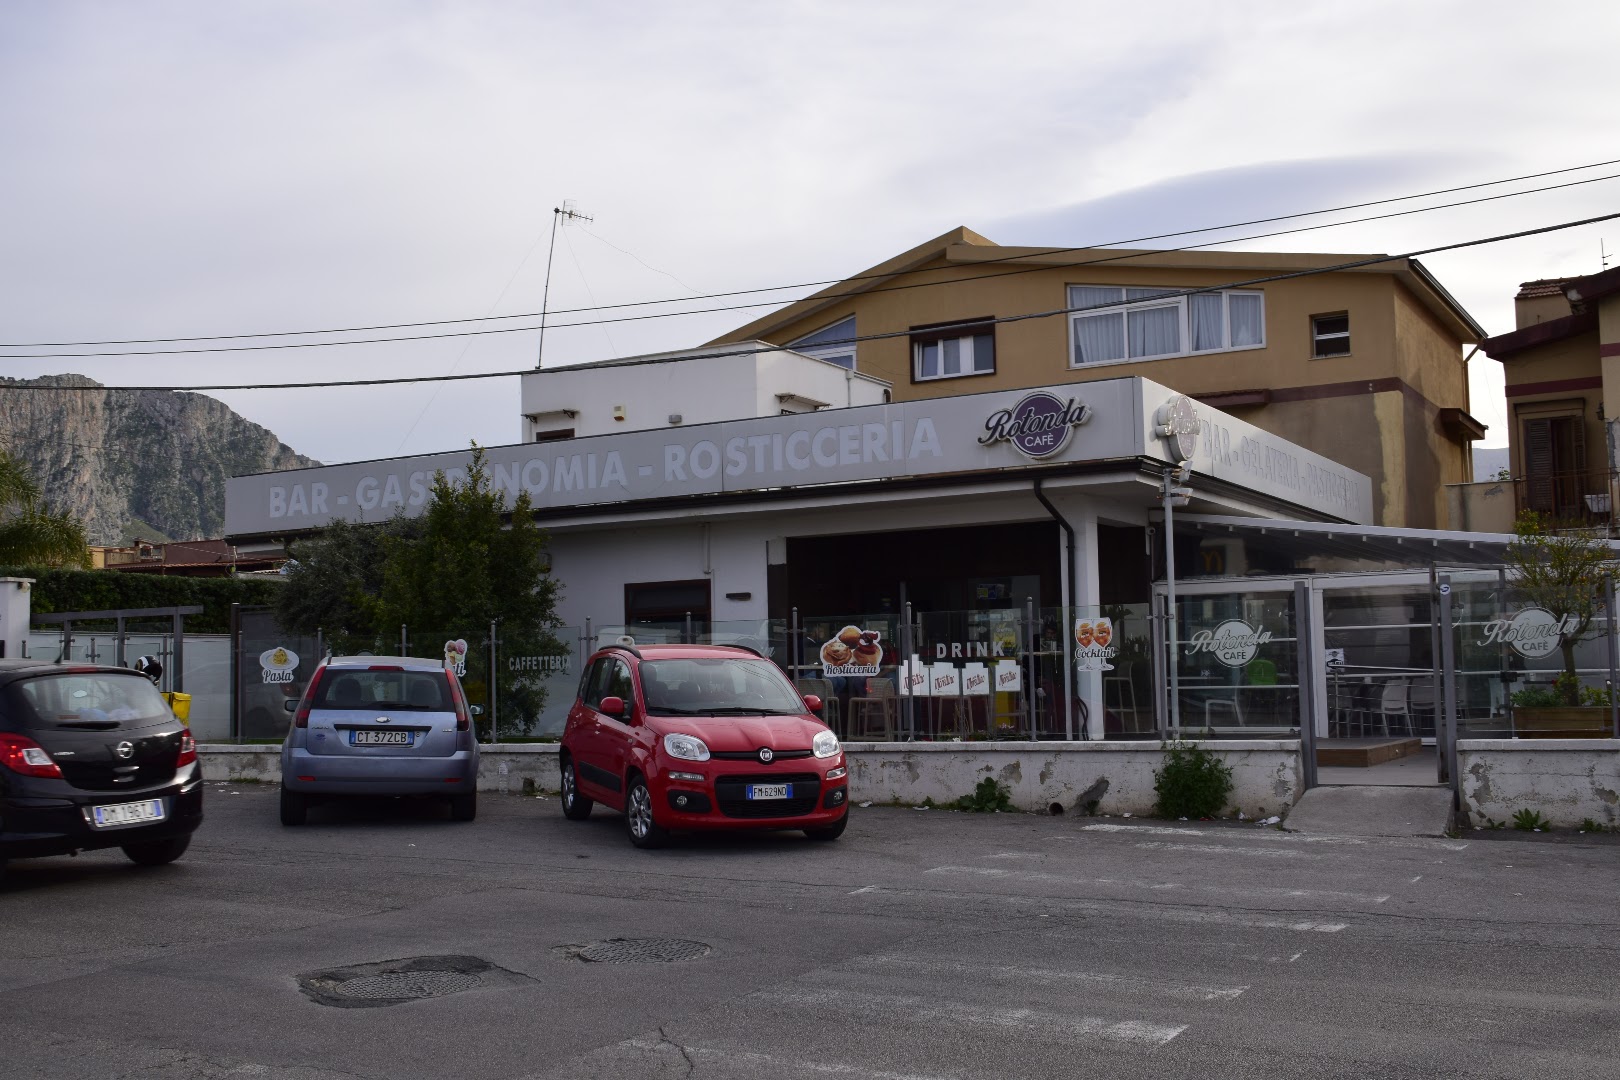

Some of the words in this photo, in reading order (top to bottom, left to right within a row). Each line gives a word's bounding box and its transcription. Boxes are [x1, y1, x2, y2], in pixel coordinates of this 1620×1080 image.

[977, 398, 1087, 444] Rotonda
[1024, 432, 1054, 447] CAFÈ
[1201, 419, 1231, 467] BAR
[1241, 435, 1300, 491] GELATERIA
[269, 481, 329, 518] BAR
[664, 416, 944, 482] ROSTICCERIA
[1477, 612, 1584, 647] Rotonda
[1184, 624, 1273, 655] Rotonda
[1521, 639, 1549, 651] CAFÈ
[936, 641, 1005, 658] DRINK
[1075, 647, 1115, 658] Cocktail
[1223, 649, 1247, 660] CAFÈ
[508, 655, 571, 671] CAFFETTERIA
[825, 663, 878, 674] Rosticceria
[263, 669, 292, 682] Pasta
